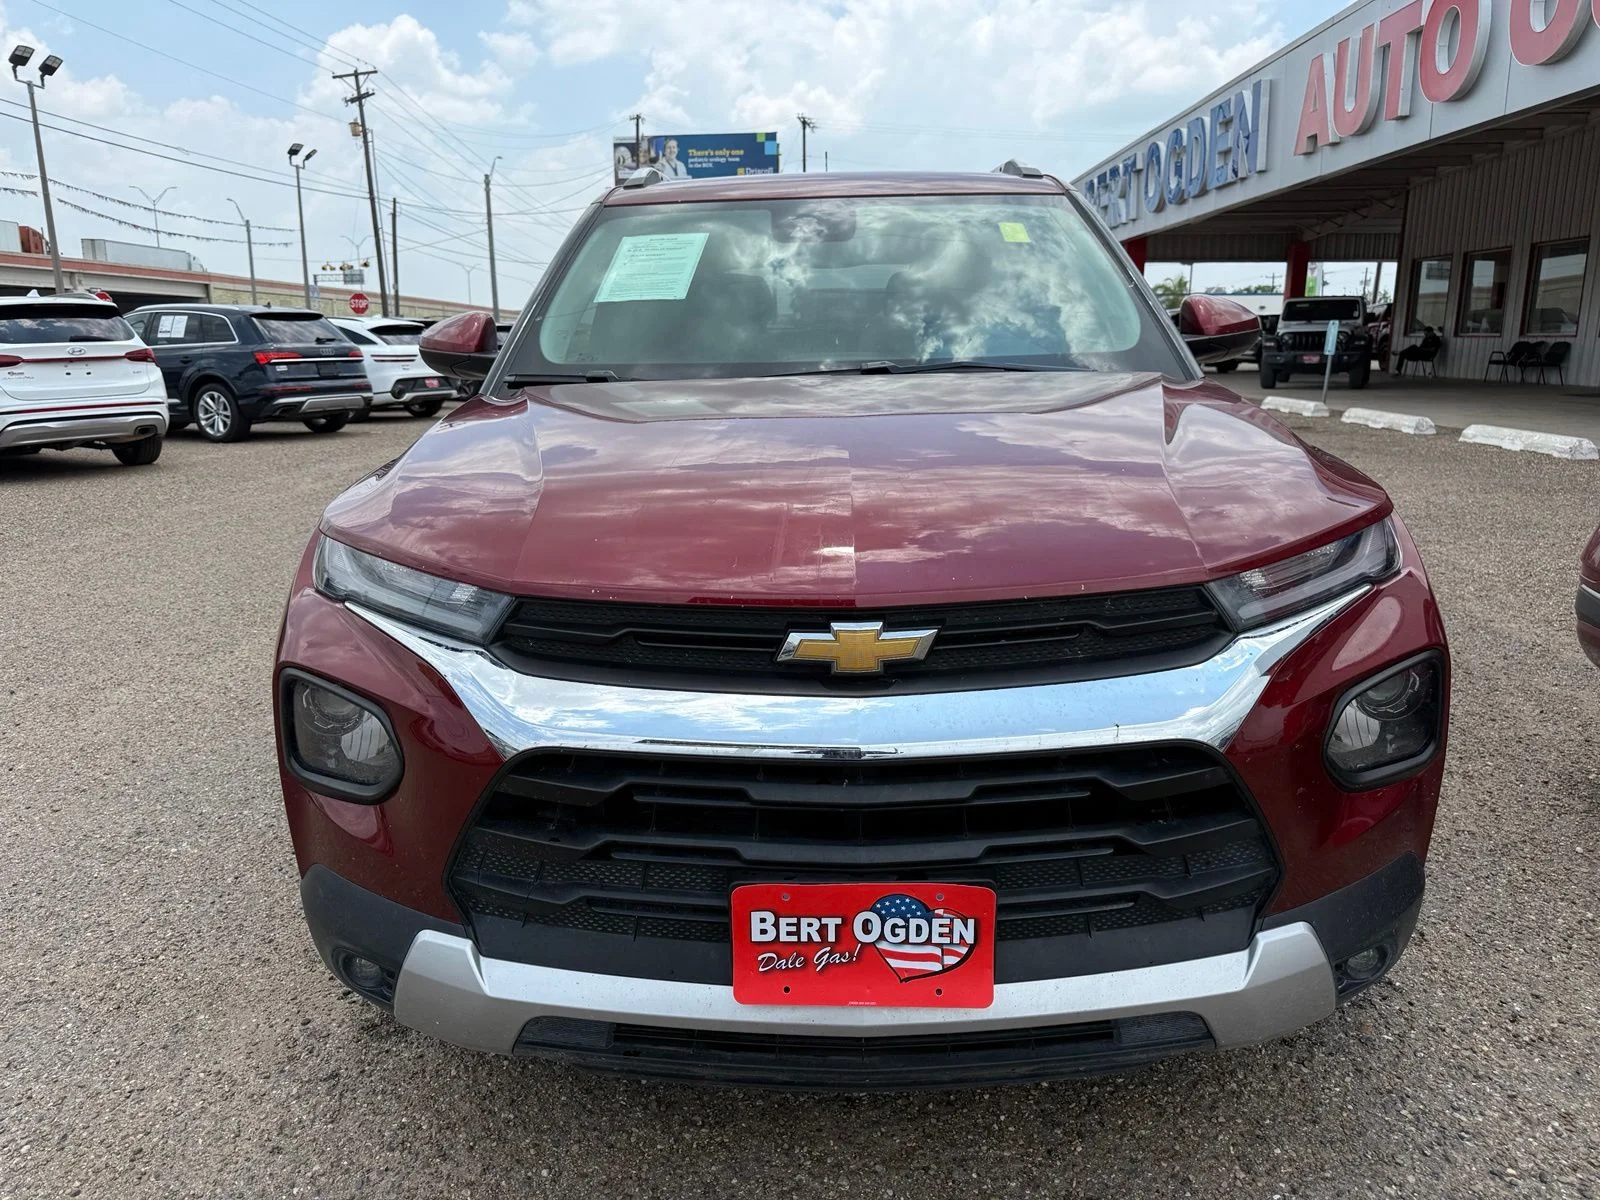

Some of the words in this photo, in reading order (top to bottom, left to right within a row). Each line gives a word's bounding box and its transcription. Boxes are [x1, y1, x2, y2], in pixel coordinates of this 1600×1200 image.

[1144, 79, 1272, 213] OGDEN
[1294, 0, 1491, 156] AUTO
[715, 148, 730, 157] only
[350, 299, 368, 309] STOP
[757, 951, 805, 972] Dale
[813, 943, 862, 972] Gas!
